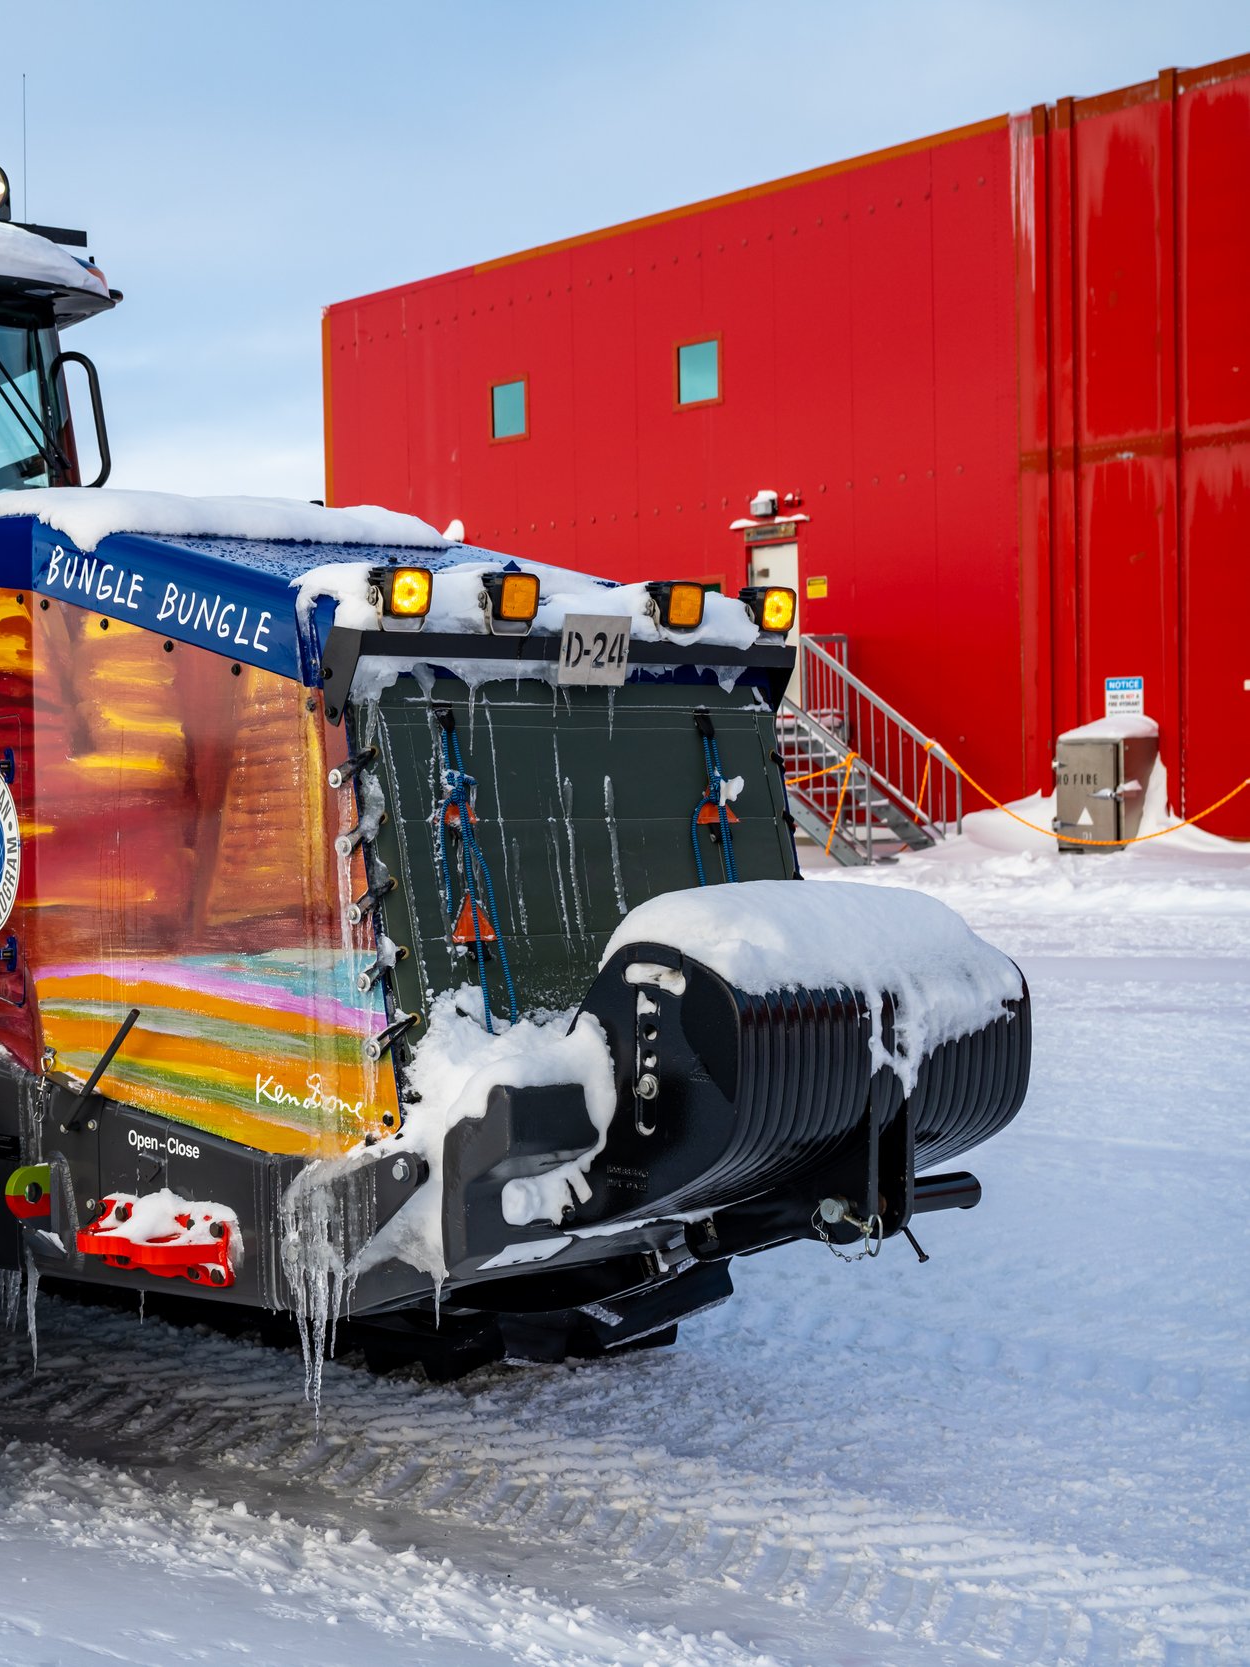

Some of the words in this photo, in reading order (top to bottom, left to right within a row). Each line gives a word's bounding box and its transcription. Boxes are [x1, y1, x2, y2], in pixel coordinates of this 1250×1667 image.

[46, 545, 144, 609] BUNGLE
[156, 582, 272, 653] BUNGLE
[565, 631, 625, 668] D-24
[1108, 680, 1140, 690] NOTICE
[1073, 773, 1098, 786] FIRE
